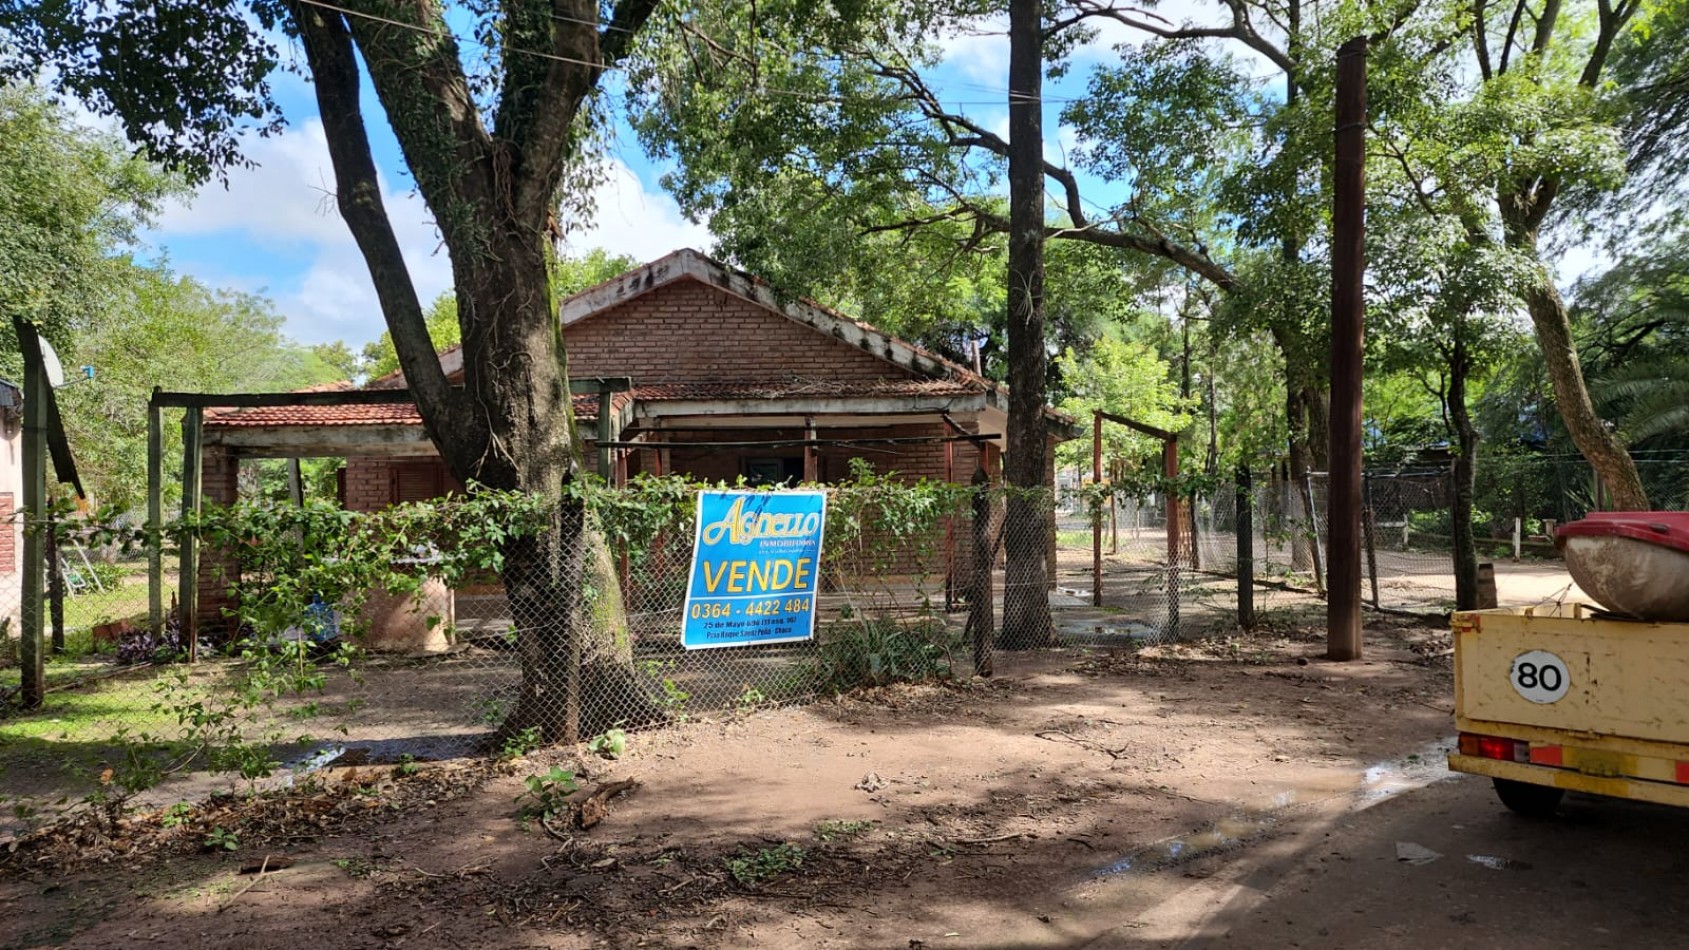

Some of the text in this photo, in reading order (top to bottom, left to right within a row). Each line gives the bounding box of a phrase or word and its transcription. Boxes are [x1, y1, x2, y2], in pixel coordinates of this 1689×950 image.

[703, 558, 811, 592] VENDE
[691, 603, 731, 619] 0364
[745, 599, 780, 616] 4422
[784, 598, 810, 613] 484
[1517, 662, 1562, 692] 80
